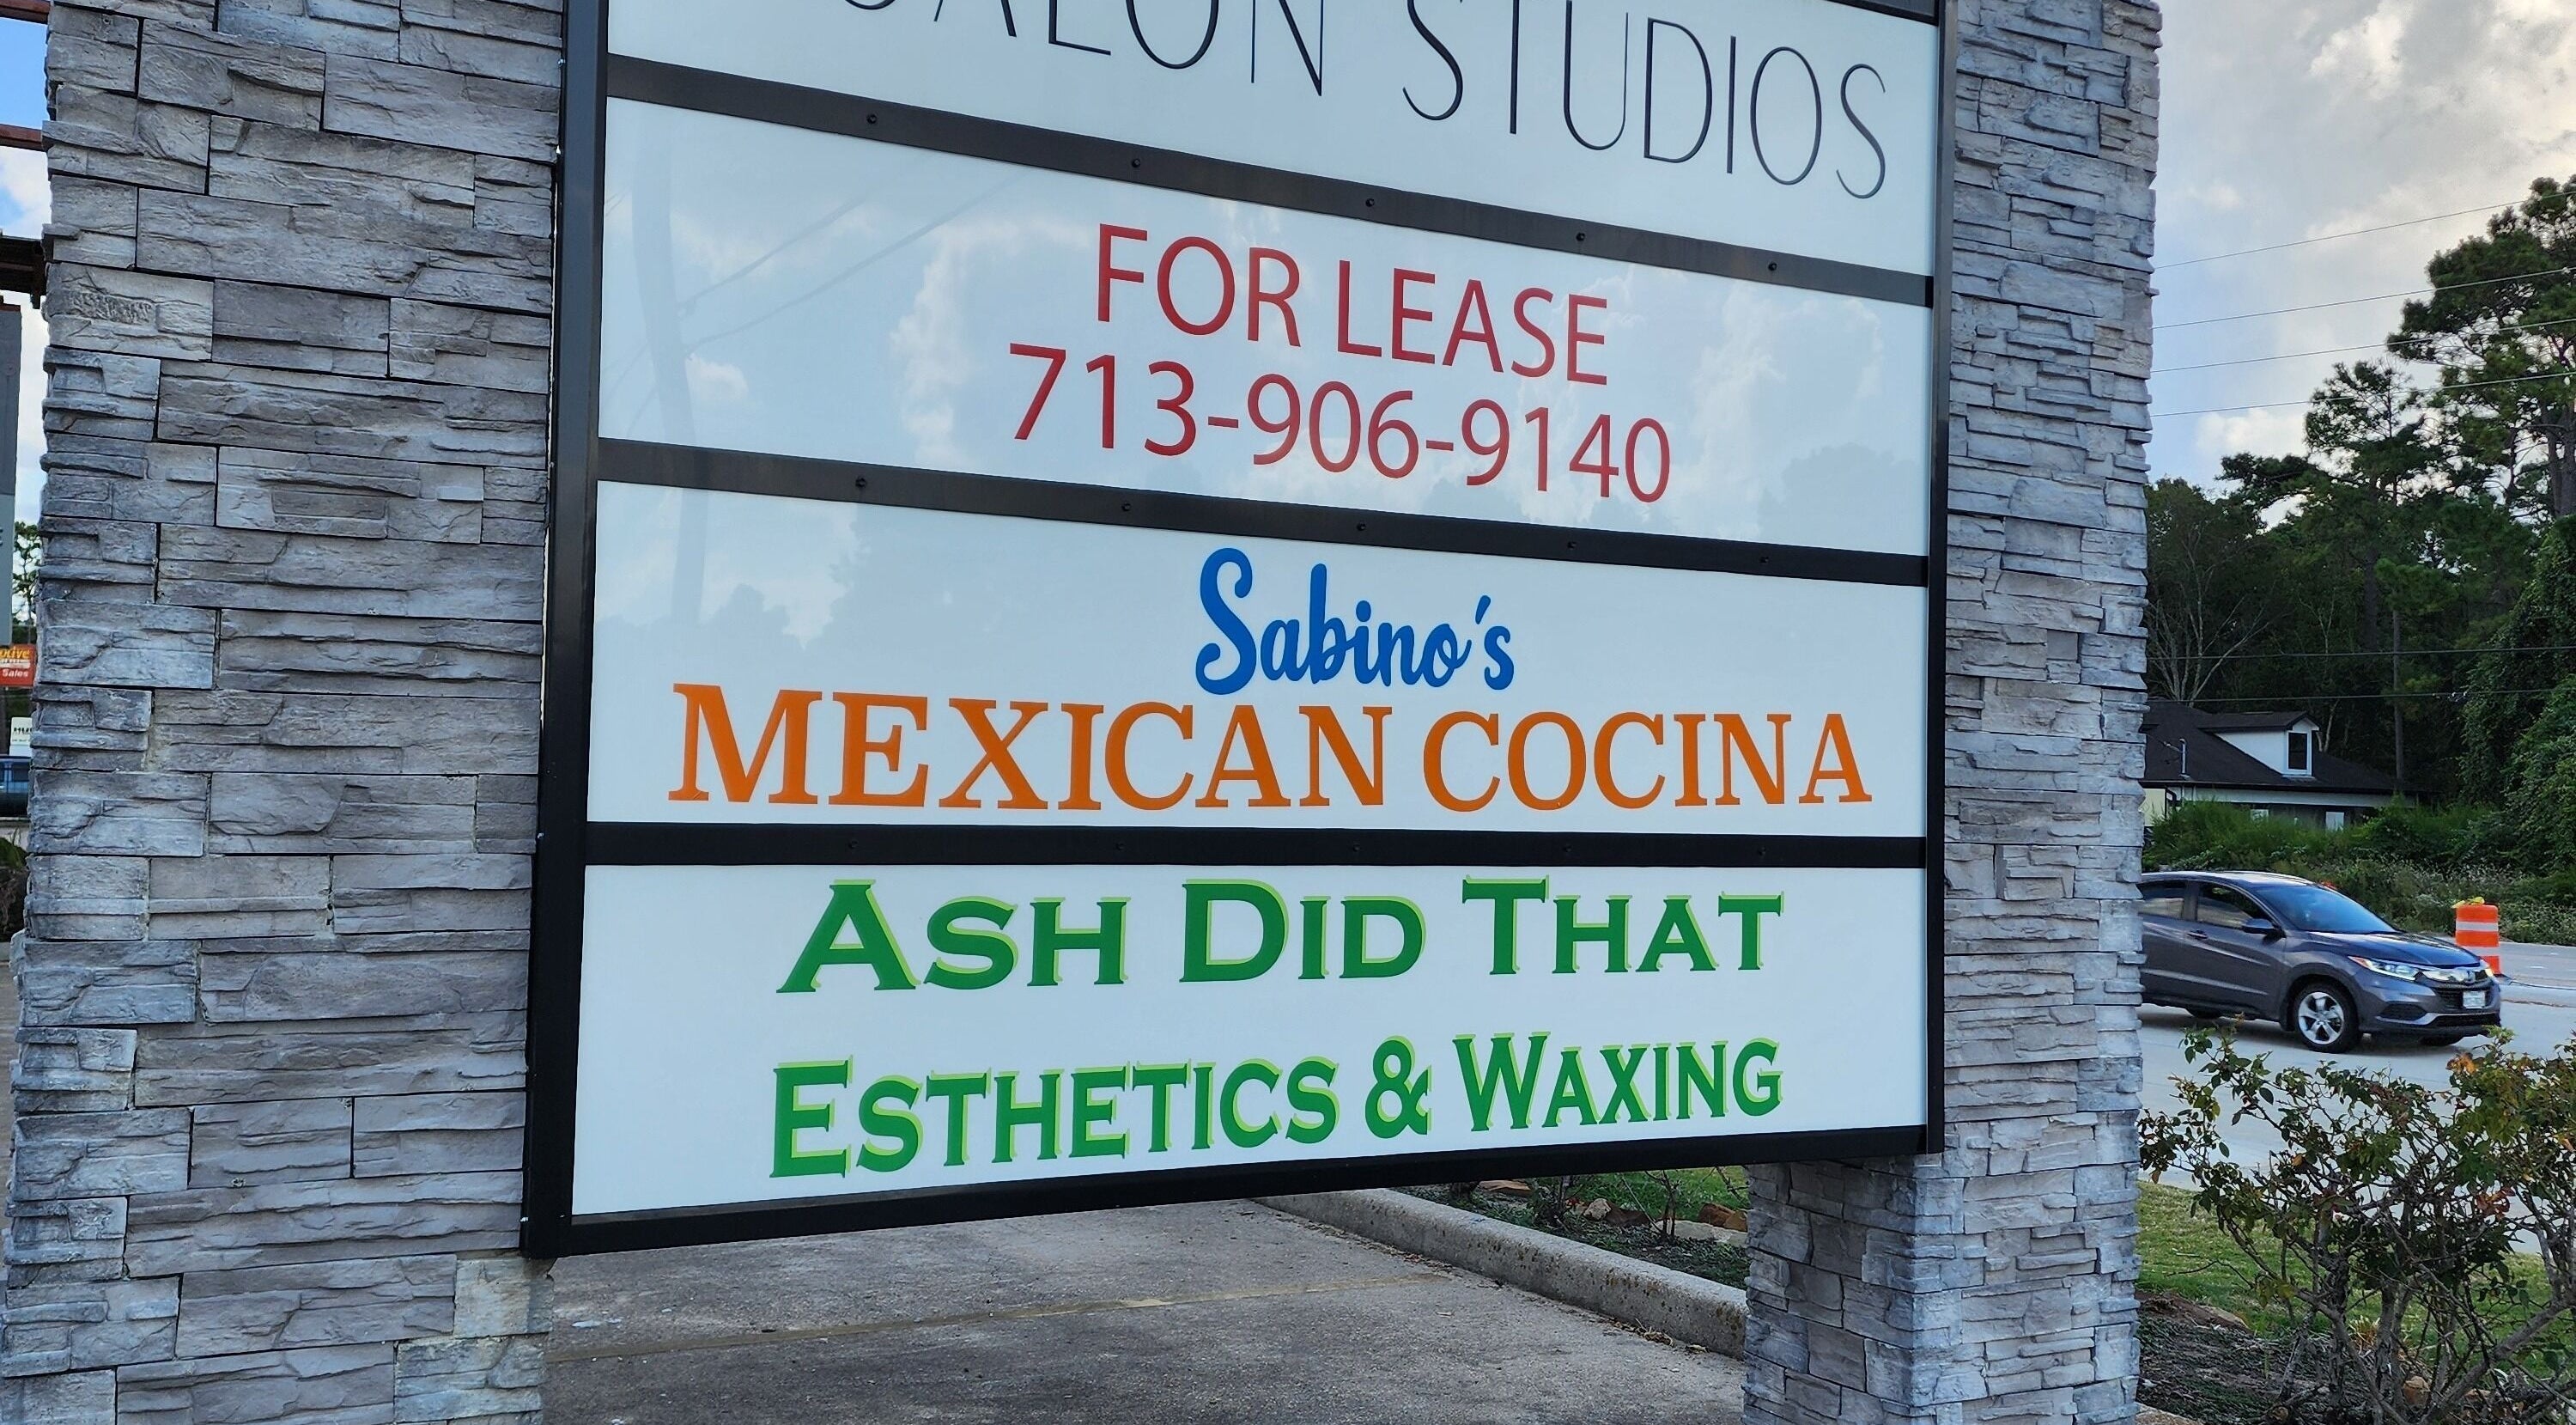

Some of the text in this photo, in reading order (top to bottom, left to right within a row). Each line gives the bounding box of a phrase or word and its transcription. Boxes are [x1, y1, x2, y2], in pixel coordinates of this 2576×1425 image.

[1403, 0, 1886, 199] STUDIOS
[1097, 223, 1608, 386] FOR LEASE
[1008, 343, 1670, 502] 713-906-9140
[1195, 547, 1515, 696] Sabino's
[668, 684, 1872, 812] MEXICAN COCINA
[1363, 1034, 1434, 1142] &
